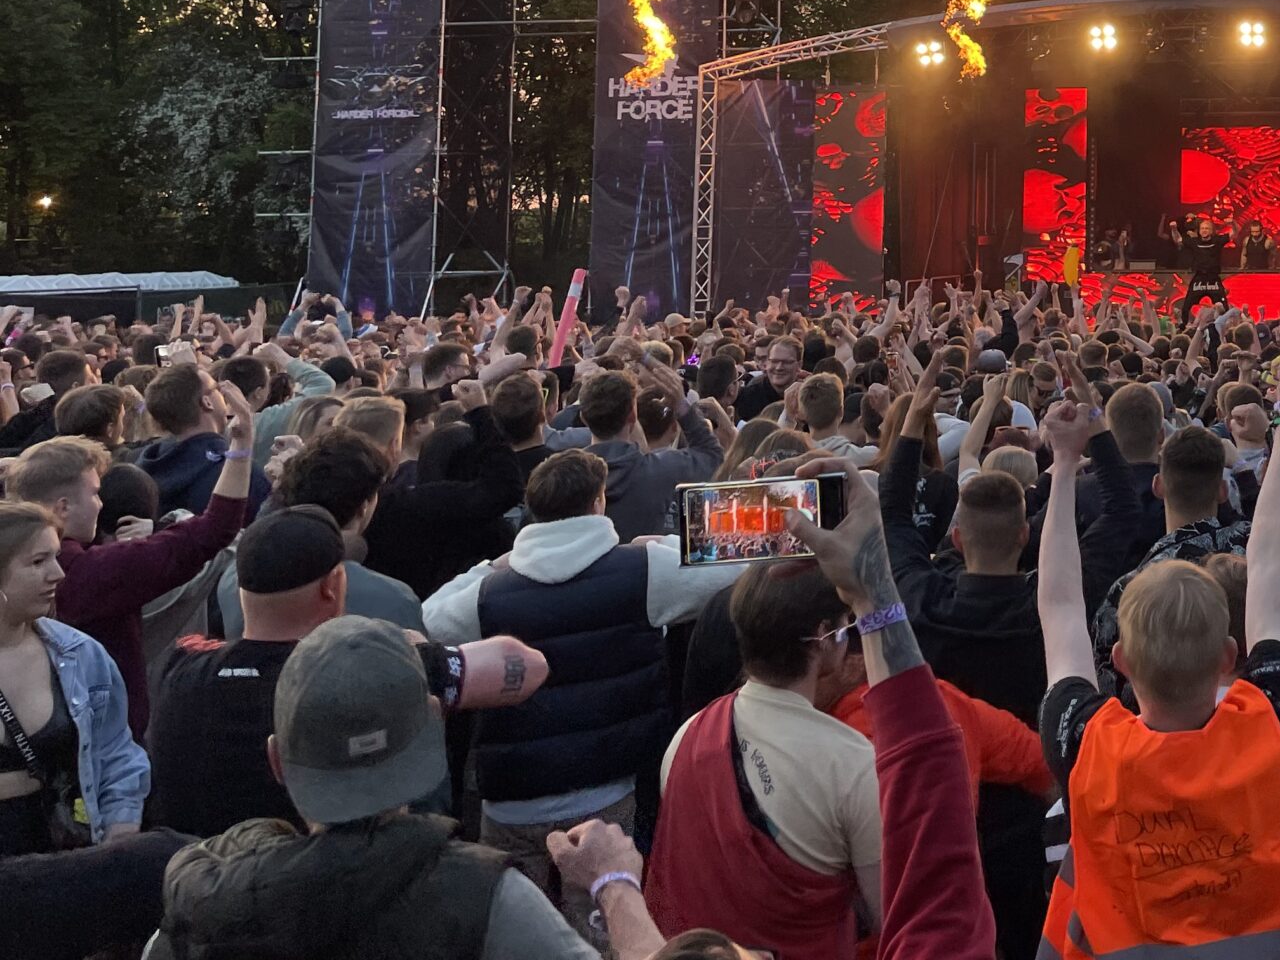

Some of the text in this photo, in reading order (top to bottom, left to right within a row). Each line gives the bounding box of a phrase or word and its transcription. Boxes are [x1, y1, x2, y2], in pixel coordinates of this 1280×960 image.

[335, 107, 374, 119] HARDER
[616, 99, 693, 123] FORCE
[14, 732, 36, 762] HXTN
